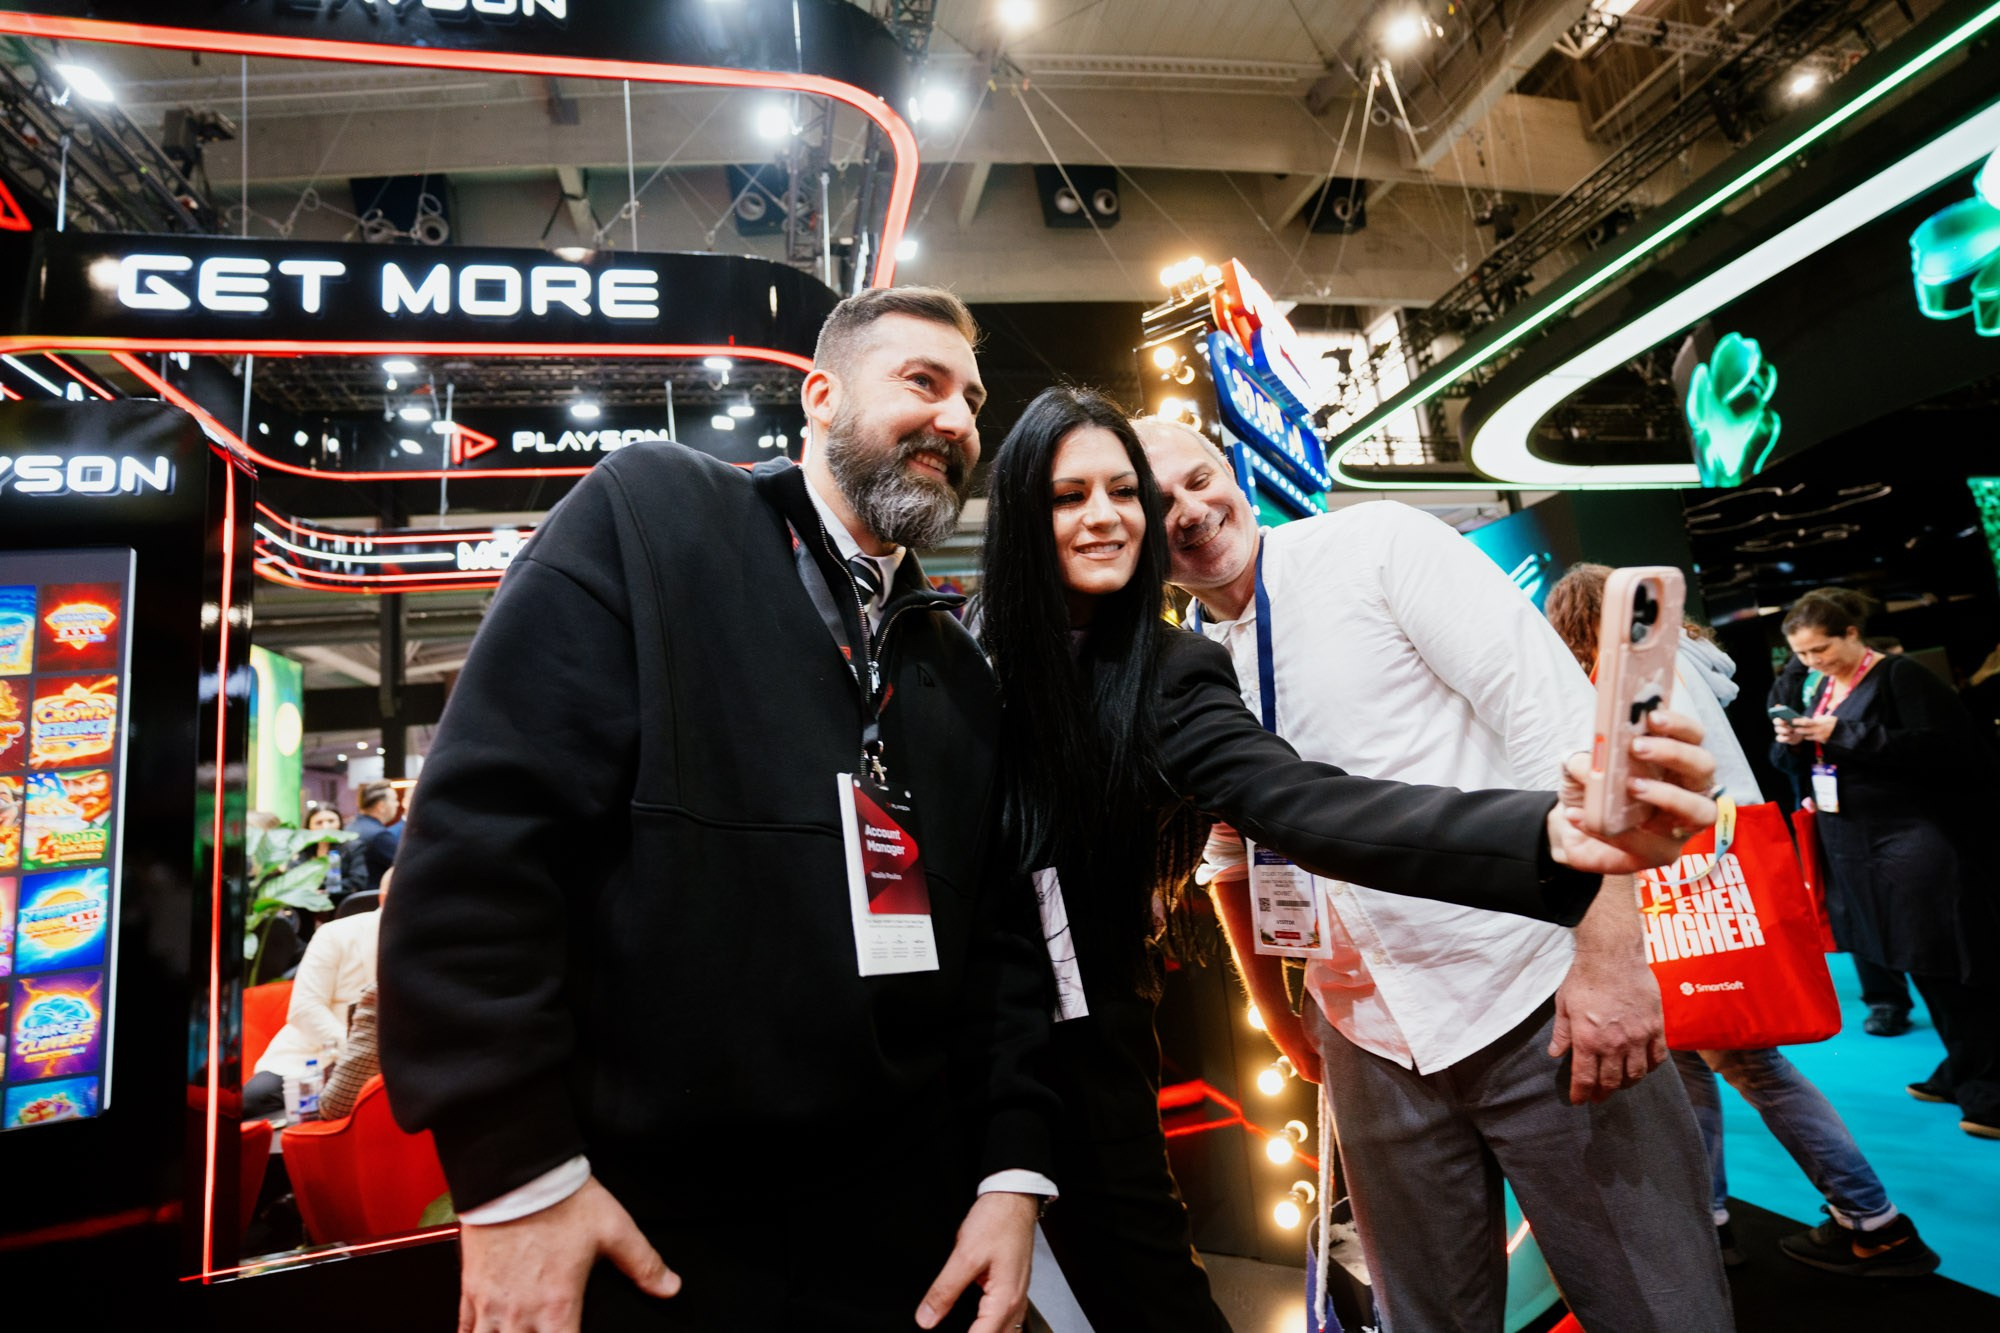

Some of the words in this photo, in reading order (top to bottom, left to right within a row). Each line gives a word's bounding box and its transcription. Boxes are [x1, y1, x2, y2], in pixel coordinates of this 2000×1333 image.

[117, 254, 347, 314] GET
[381, 262, 660, 319] MORE
[457, 541, 529, 571] MO
[38, 706, 111, 724] CROWN
[865, 824, 901, 840] Account
[35, 833, 57, 861] 4
[866, 839, 905, 857] Manager
[1675, 883, 1756, 914] EVEN
[1641, 912, 1766, 964] HIGHER
[1695, 980, 1744, 993] SmartSoft
